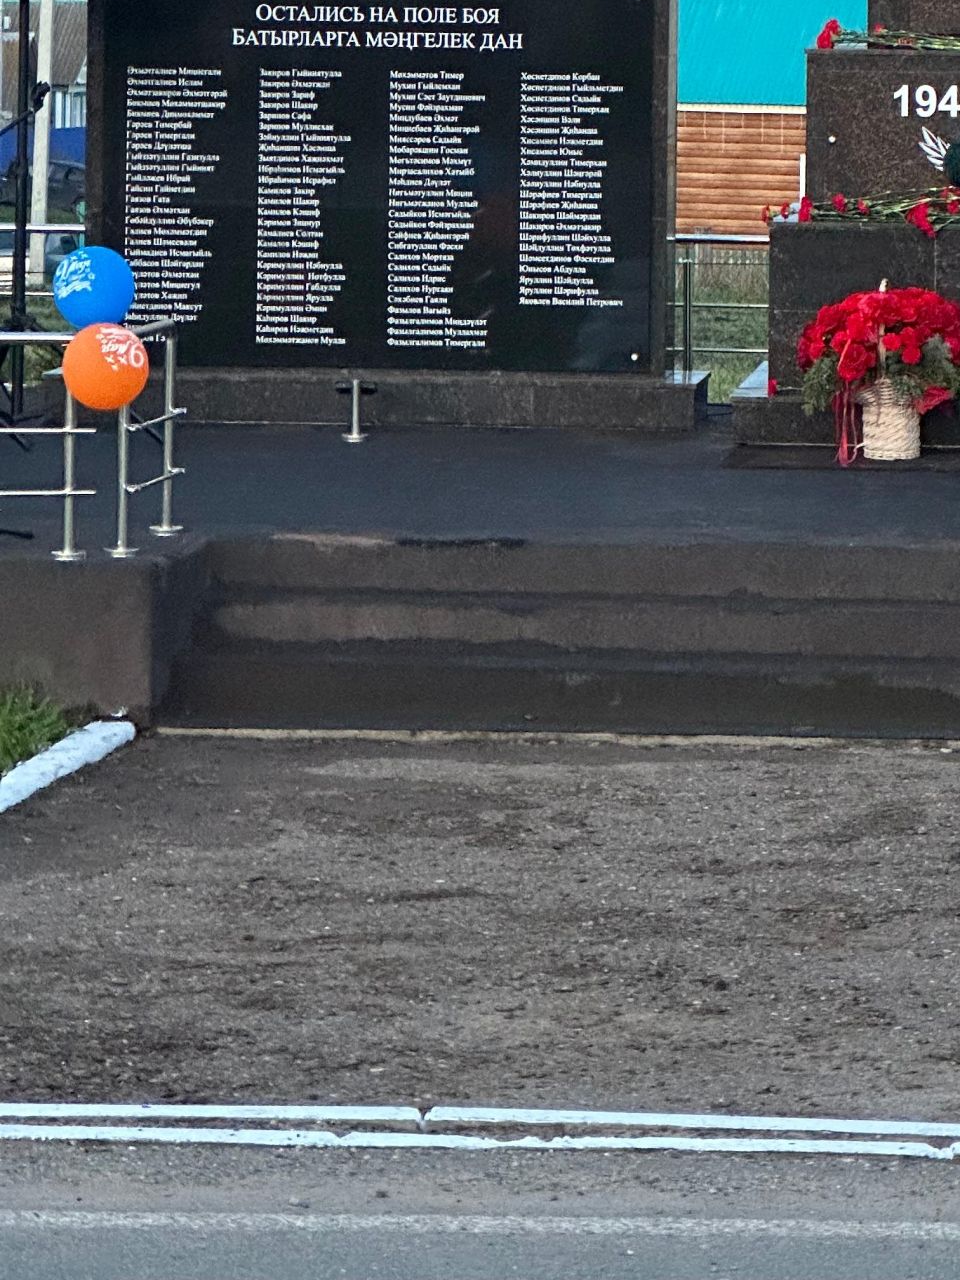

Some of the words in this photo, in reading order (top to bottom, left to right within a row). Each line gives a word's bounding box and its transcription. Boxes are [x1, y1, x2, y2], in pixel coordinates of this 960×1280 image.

[255, 4, 364, 22] ОСТАЛИСЬ
[369, 6, 398, 23] НА
[403, 7, 457, 24] ПОЛЕ
[462, 8, 500, 24] БОЯ
[232, 28, 361, 47] БАТЫРЛАРГА
[365, 31, 476, 51] МӘҢГЕЛЕК
[479, 33, 524, 51] ДАН
